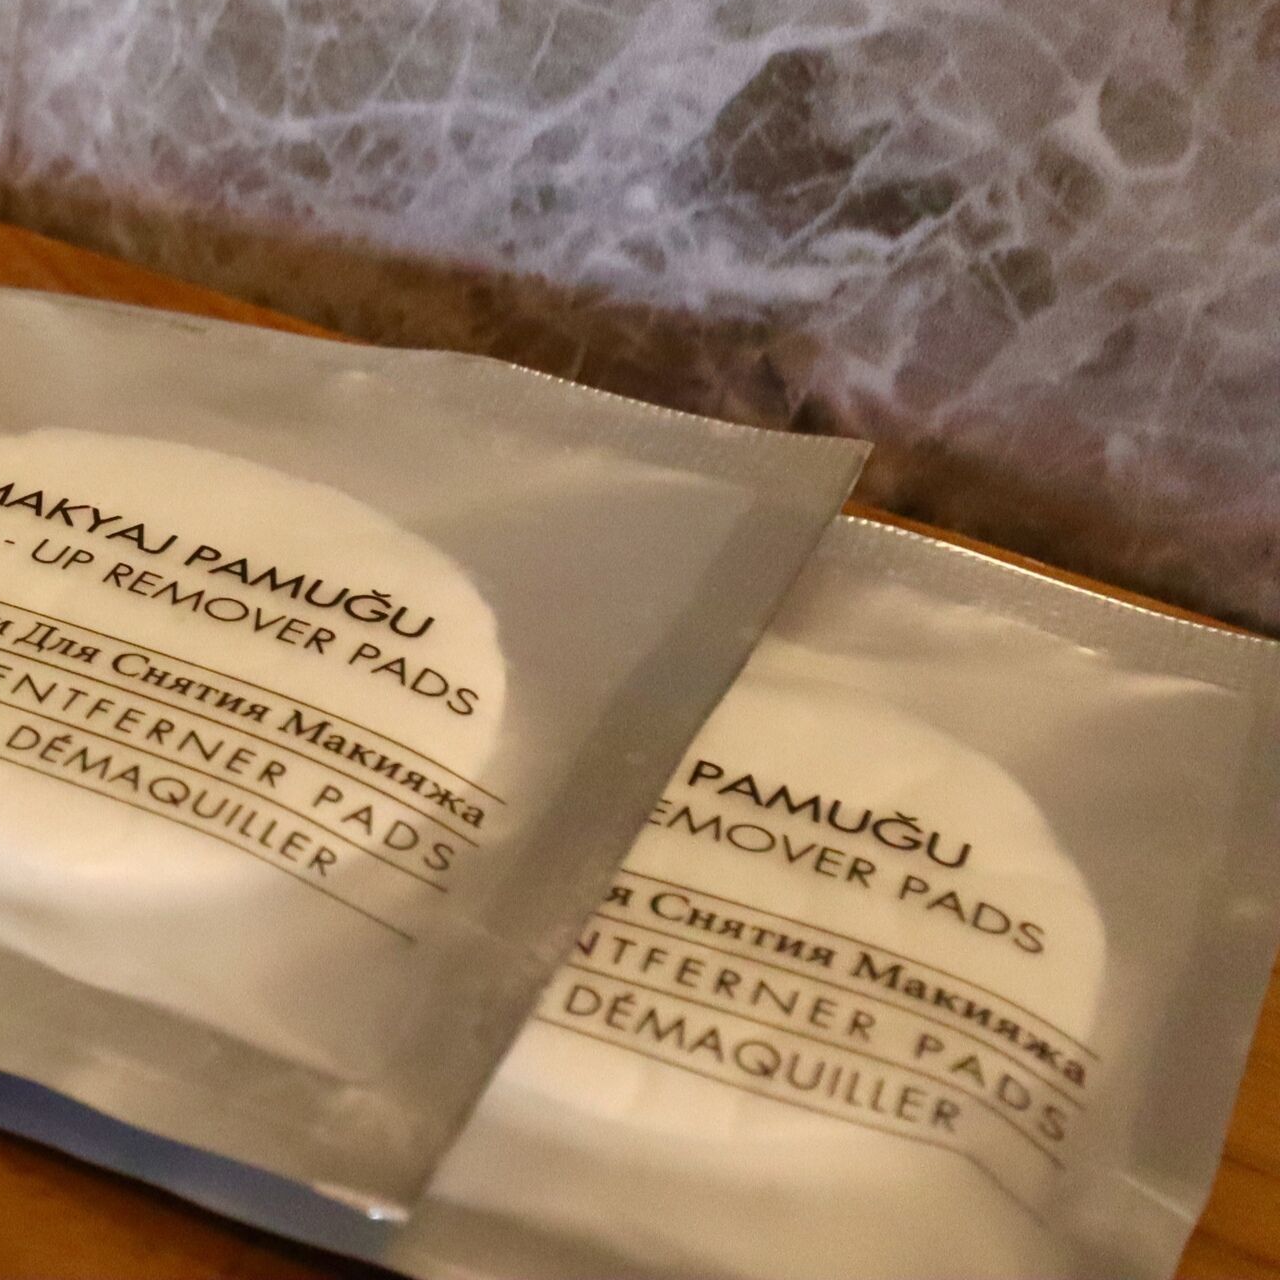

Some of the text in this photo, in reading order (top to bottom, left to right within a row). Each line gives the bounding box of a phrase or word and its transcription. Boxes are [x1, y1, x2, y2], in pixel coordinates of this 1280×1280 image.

[31, 538, 95, 571] UP
[102, 562, 337, 655] REMOVER
[348, 642, 480, 717] PADS
[183, 544, 436, 639] PAMUĞU
[14, 621, 102, 664] Для
[111, 652, 272, 724] Снятия
[278, 709, 486, 829] Макияжа
[9, 723, 338, 878] DÉMAQUILLER
[312, 784, 455, 873] PADS
[686, 759, 972, 870] PAMUĞU
[898, 875, 1045, 954] PADS
[650, 887, 1086, 1088] Снятия Макияжа
[564, 980, 962, 1132] DÉMAQUILLER
[914, 1033, 1066, 1143] PADS
